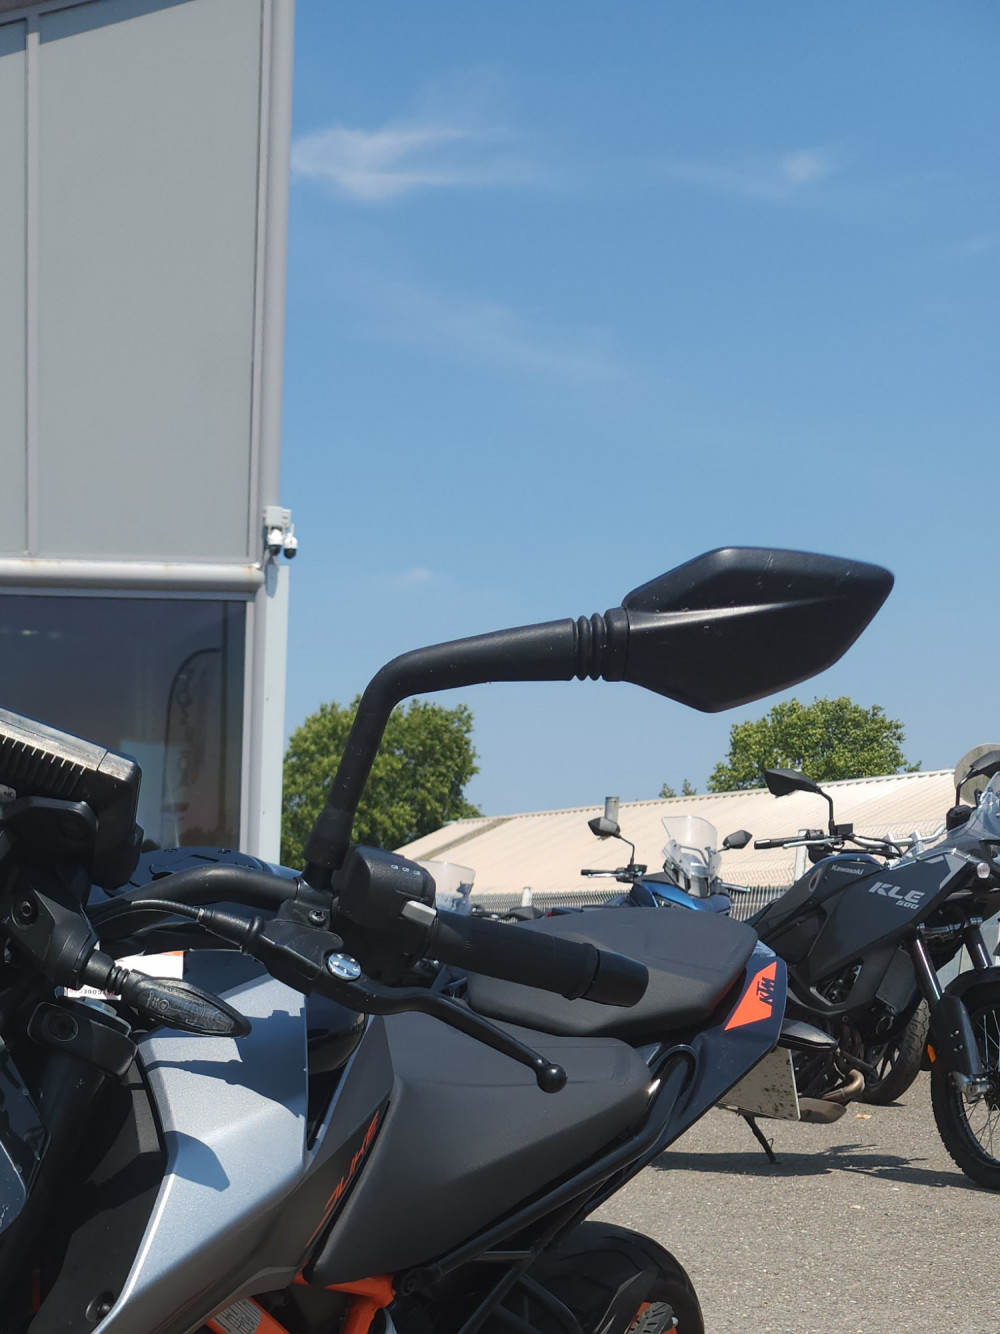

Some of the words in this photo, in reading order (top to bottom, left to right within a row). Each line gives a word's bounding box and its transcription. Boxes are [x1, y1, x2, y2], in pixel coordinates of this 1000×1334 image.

[831, 864, 864, 876] Kawasaki
[868, 881, 925, 903] KLE
[895, 899, 920, 911] 500
[756, 976, 776, 1006] KTM
